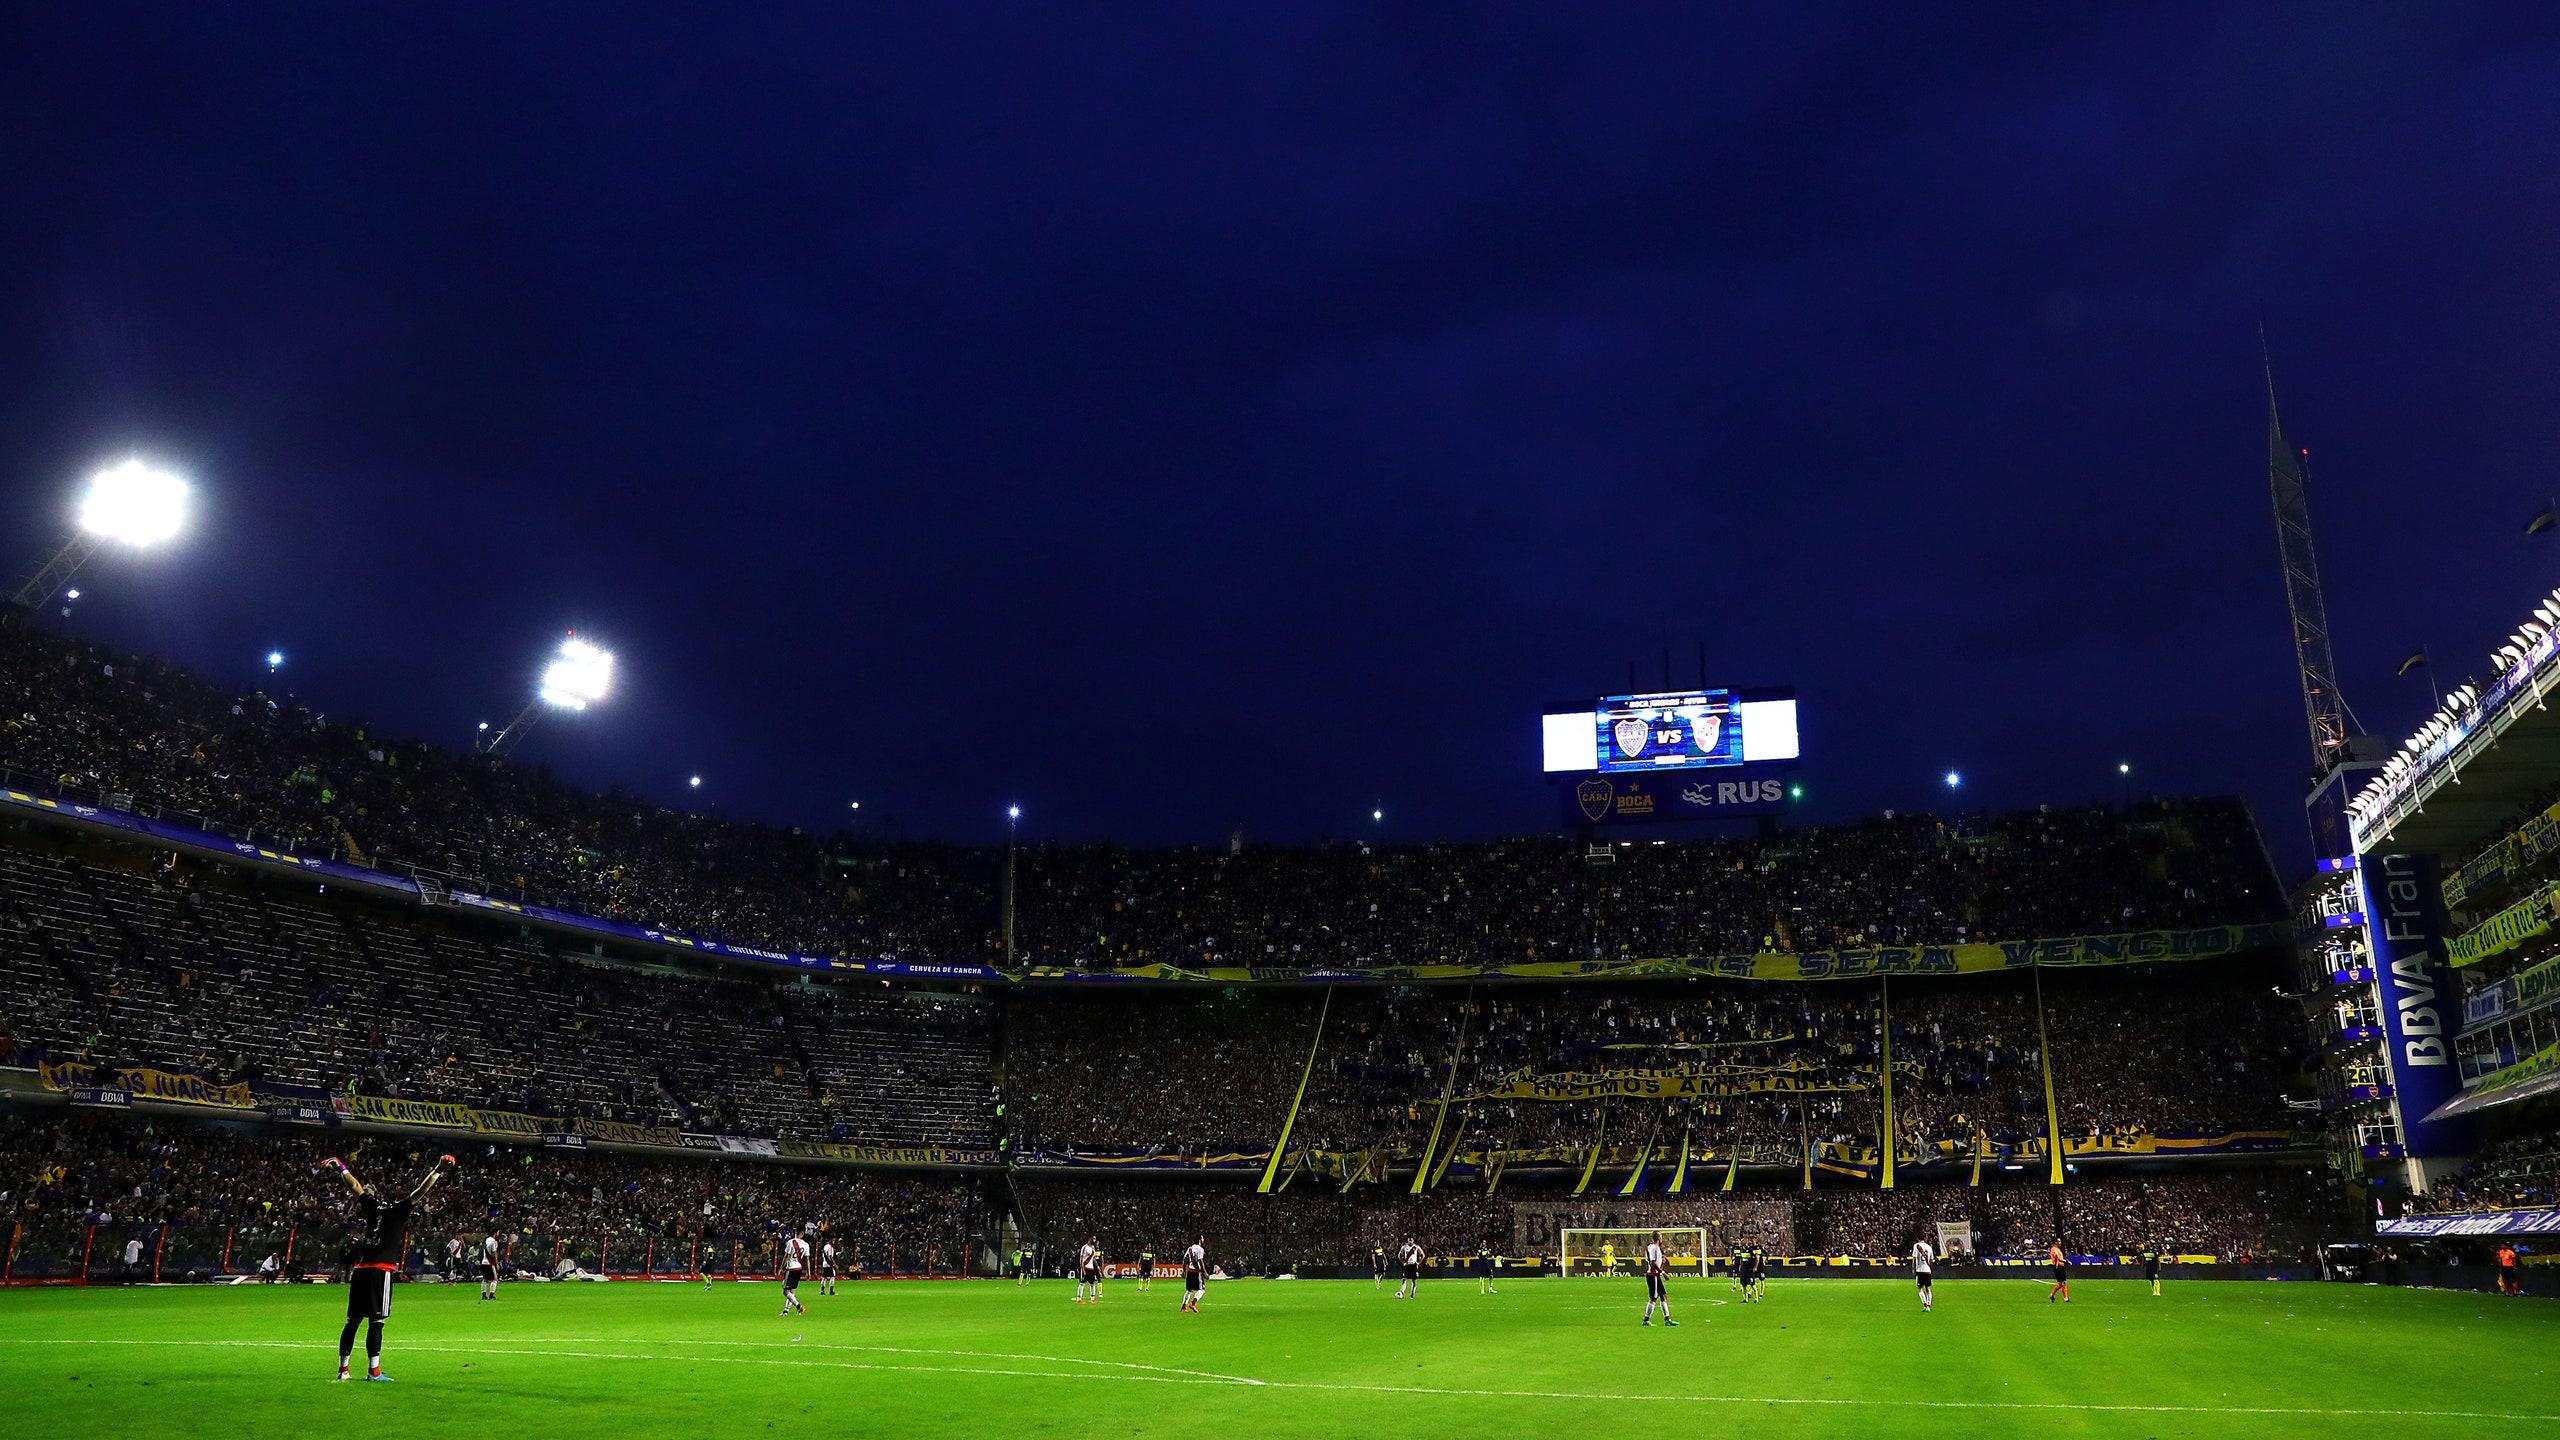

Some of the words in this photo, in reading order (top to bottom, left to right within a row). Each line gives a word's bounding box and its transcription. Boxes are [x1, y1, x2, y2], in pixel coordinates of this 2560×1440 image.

[1656, 729, 1683, 744] VS
[1582, 791, 1609, 802] CABJ
[1716, 779, 1784, 805] RUS
[1616, 794, 1654, 809] BOCA
[2479, 920, 2503, 953] BOCA
[2501, 912, 2516, 941] ES
[909, 964, 941, 974] CERVEZA
[942, 965, 951, 974] DE
[953, 965, 983, 975] CANCHA
[1798, 946, 1956, 978] SERA
[2390, 950, 2449, 1066] BBVA
[100, 1092, 125, 1104] BBVA
[299, 1107, 320, 1119] BBVA
[354, 1097, 387, 1119] SAN
[389, 1101, 463, 1126] CRISTOBAL
[565, 1134, 582, 1146] BBVA
[584, 1118, 682, 1147] BRANDSEN
[838, 1146, 943, 1163] GARRAHAN
